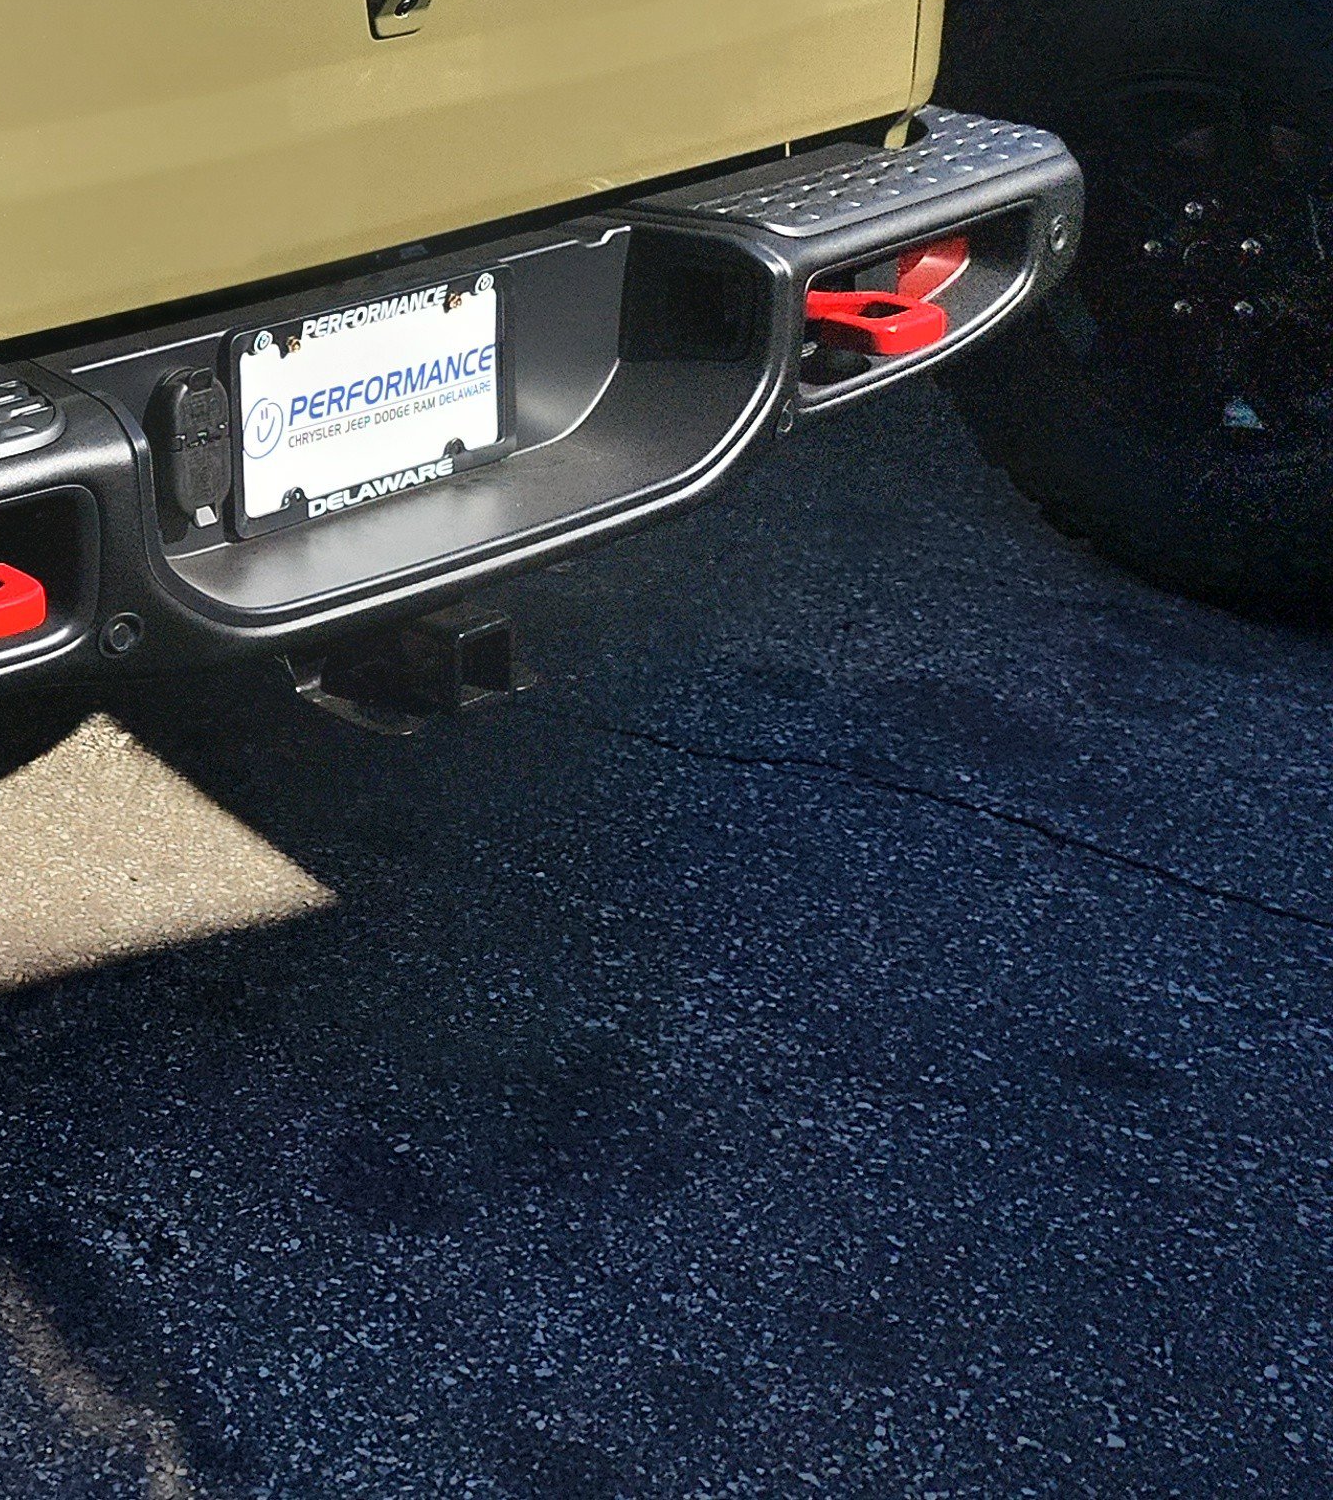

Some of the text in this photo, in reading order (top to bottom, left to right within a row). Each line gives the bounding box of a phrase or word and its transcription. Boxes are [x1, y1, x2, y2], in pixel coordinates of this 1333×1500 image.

[302, 284, 448, 338] PERFORMANCE
[288, 345, 495, 426] PERFORMANCE
[288, 379, 492, 449] CHRYSLER JEEP DODGE RAM DELAWARE
[308, 457, 455, 518] DELAWARE
